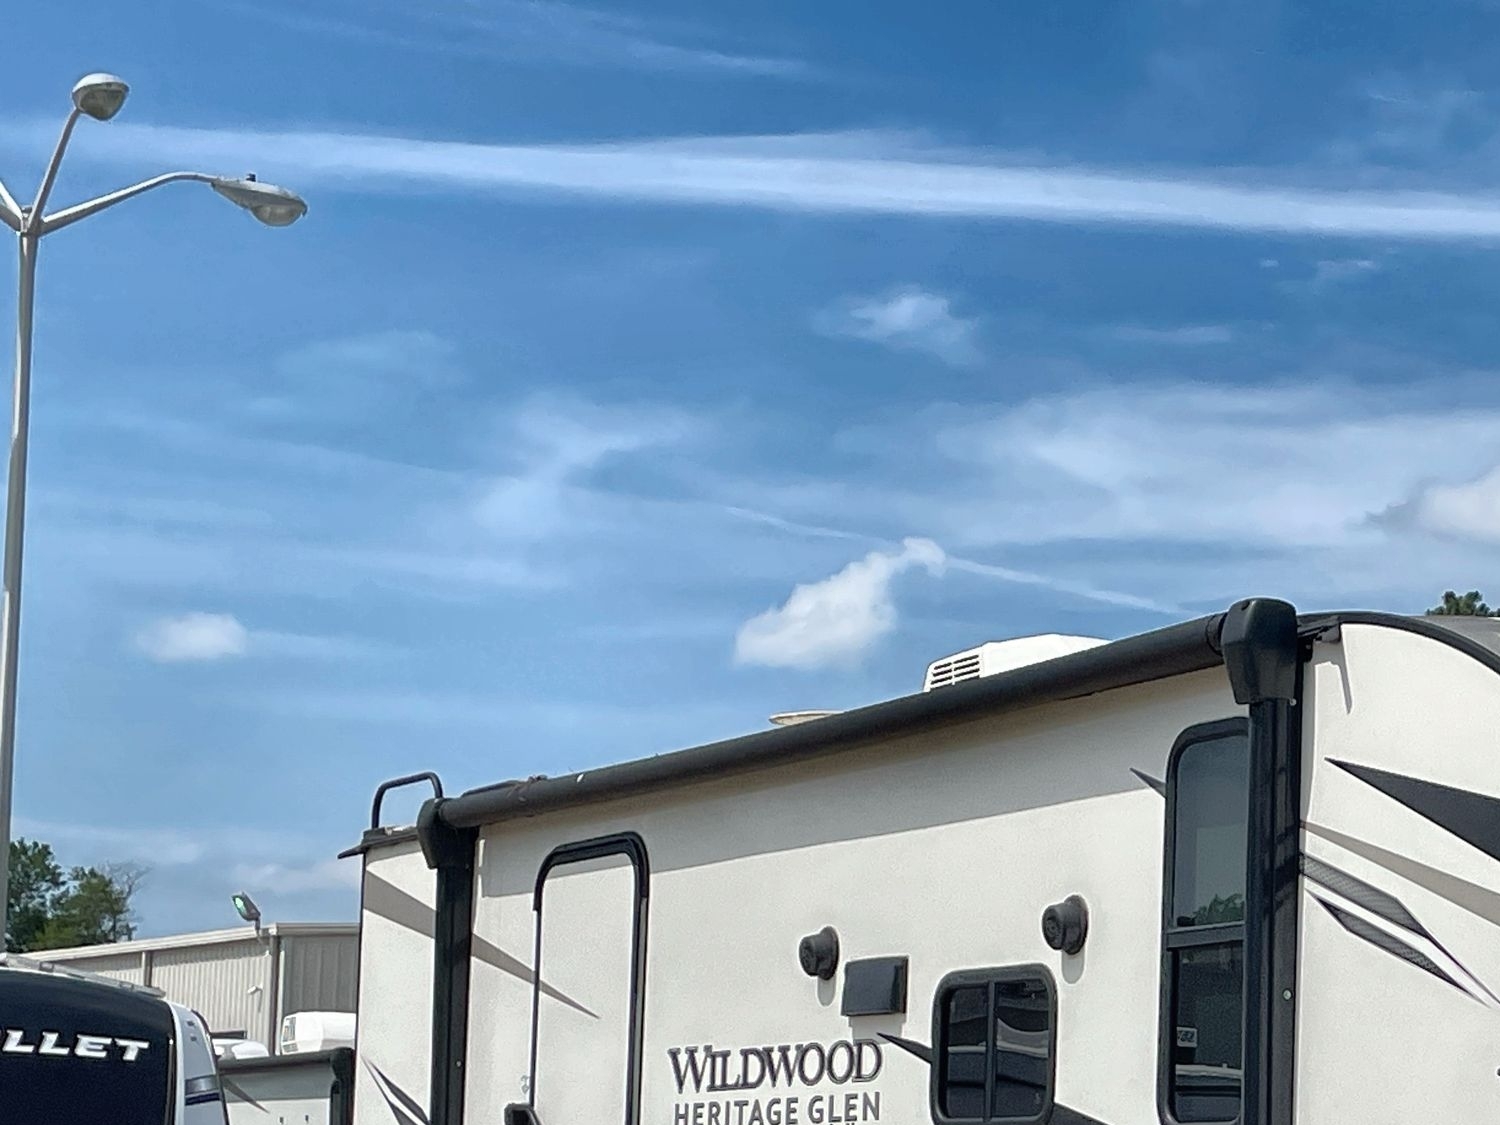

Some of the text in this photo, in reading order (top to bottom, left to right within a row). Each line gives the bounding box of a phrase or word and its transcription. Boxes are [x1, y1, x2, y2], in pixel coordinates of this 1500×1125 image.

[2, 1029, 150, 1062] LLET
[667, 1038, 883, 1095] WILDWOOD
[807, 1091, 881, 1125] GLEN
